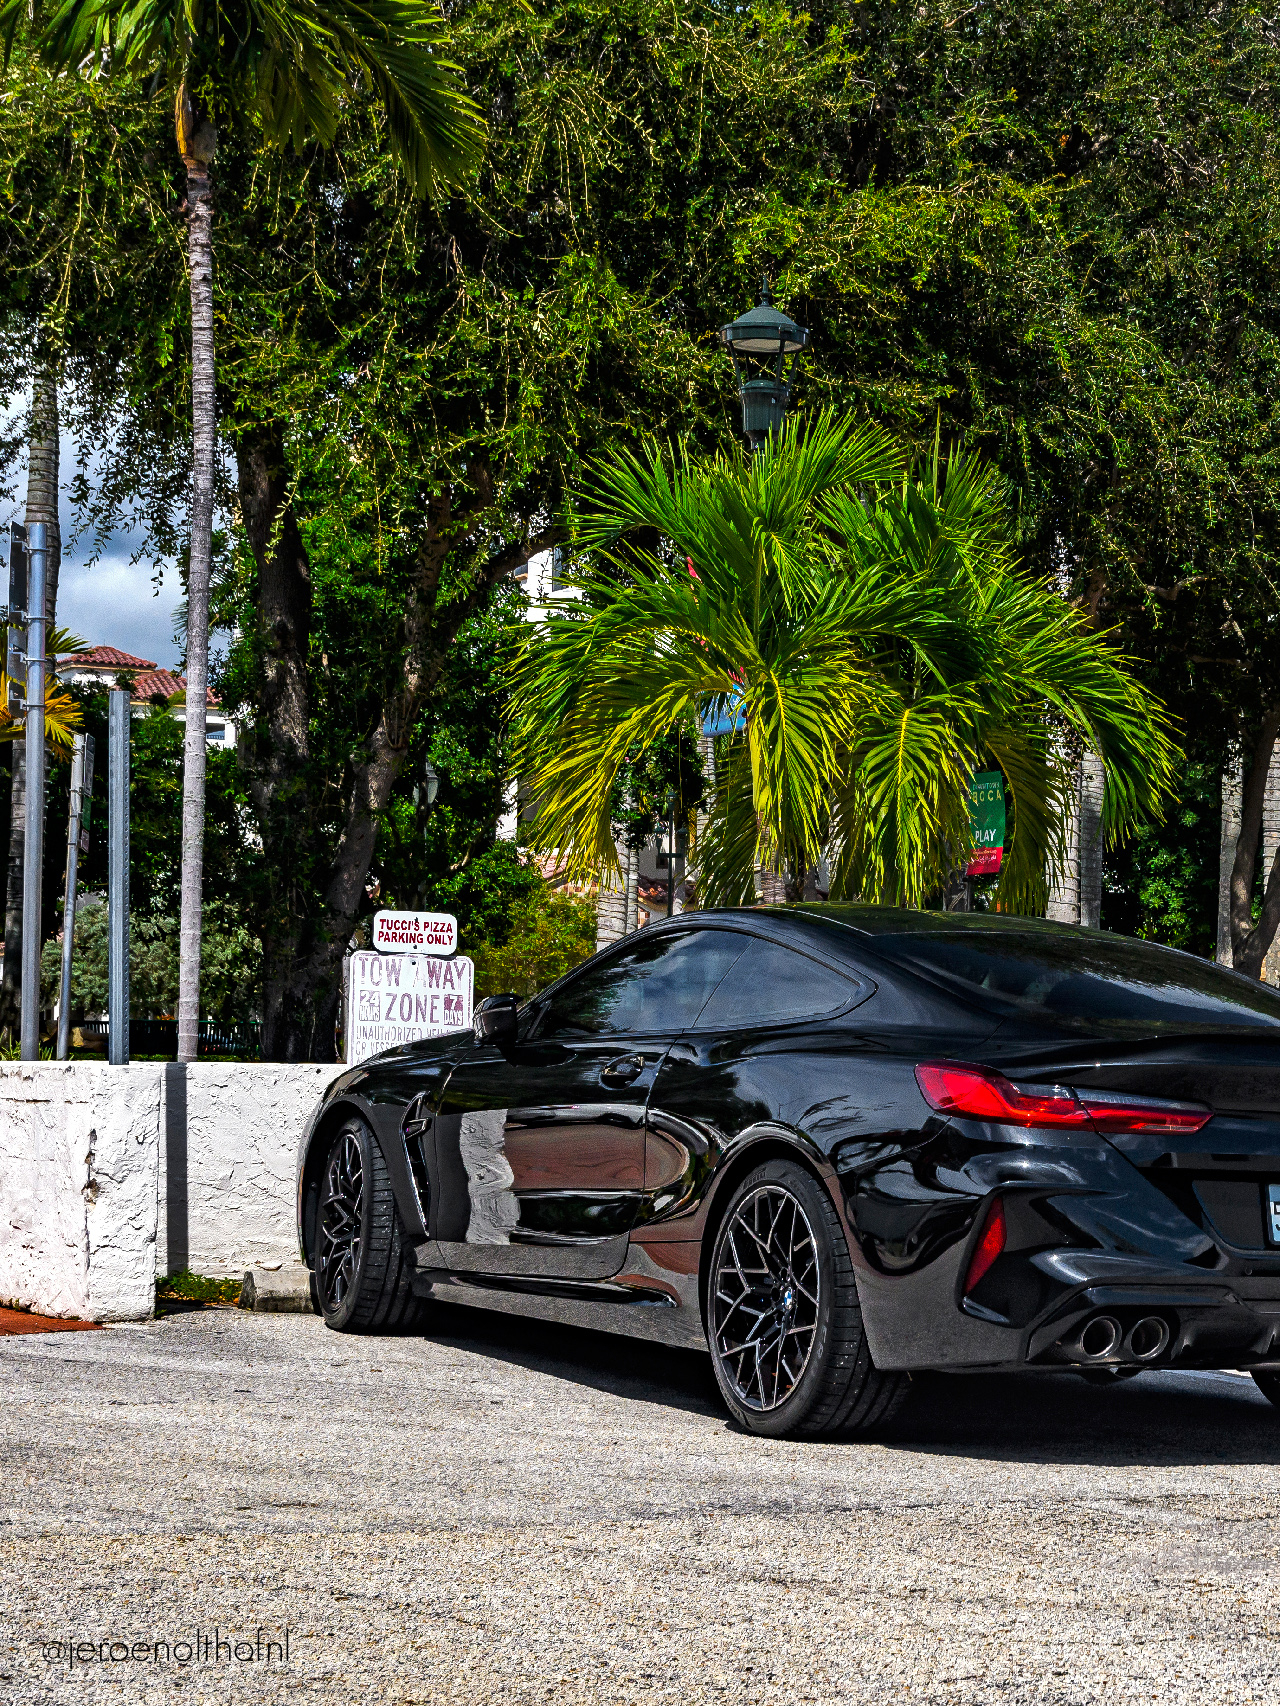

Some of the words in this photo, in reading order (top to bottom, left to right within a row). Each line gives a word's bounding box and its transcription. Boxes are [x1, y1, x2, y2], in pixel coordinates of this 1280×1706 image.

[973, 790, 1002, 802] BOCA
[975, 829, 996, 843] PLAY
[379, 919, 420, 932] TUCCI'S
[423, 922, 453, 934] PIZZA
[377, 931, 424, 944] PARKING
[427, 934, 454, 946] ONLY
[358, 957, 402, 987] TOW
[412, 960, 467, 990] AWAY
[360, 990, 380, 1006] 24
[449, 995, 458, 1010] 7
[385, 993, 440, 1023] ZONE
[444, 1010, 463, 1026] DAYS
[356, 1026, 423, 1041] UNAUTHORIZED
